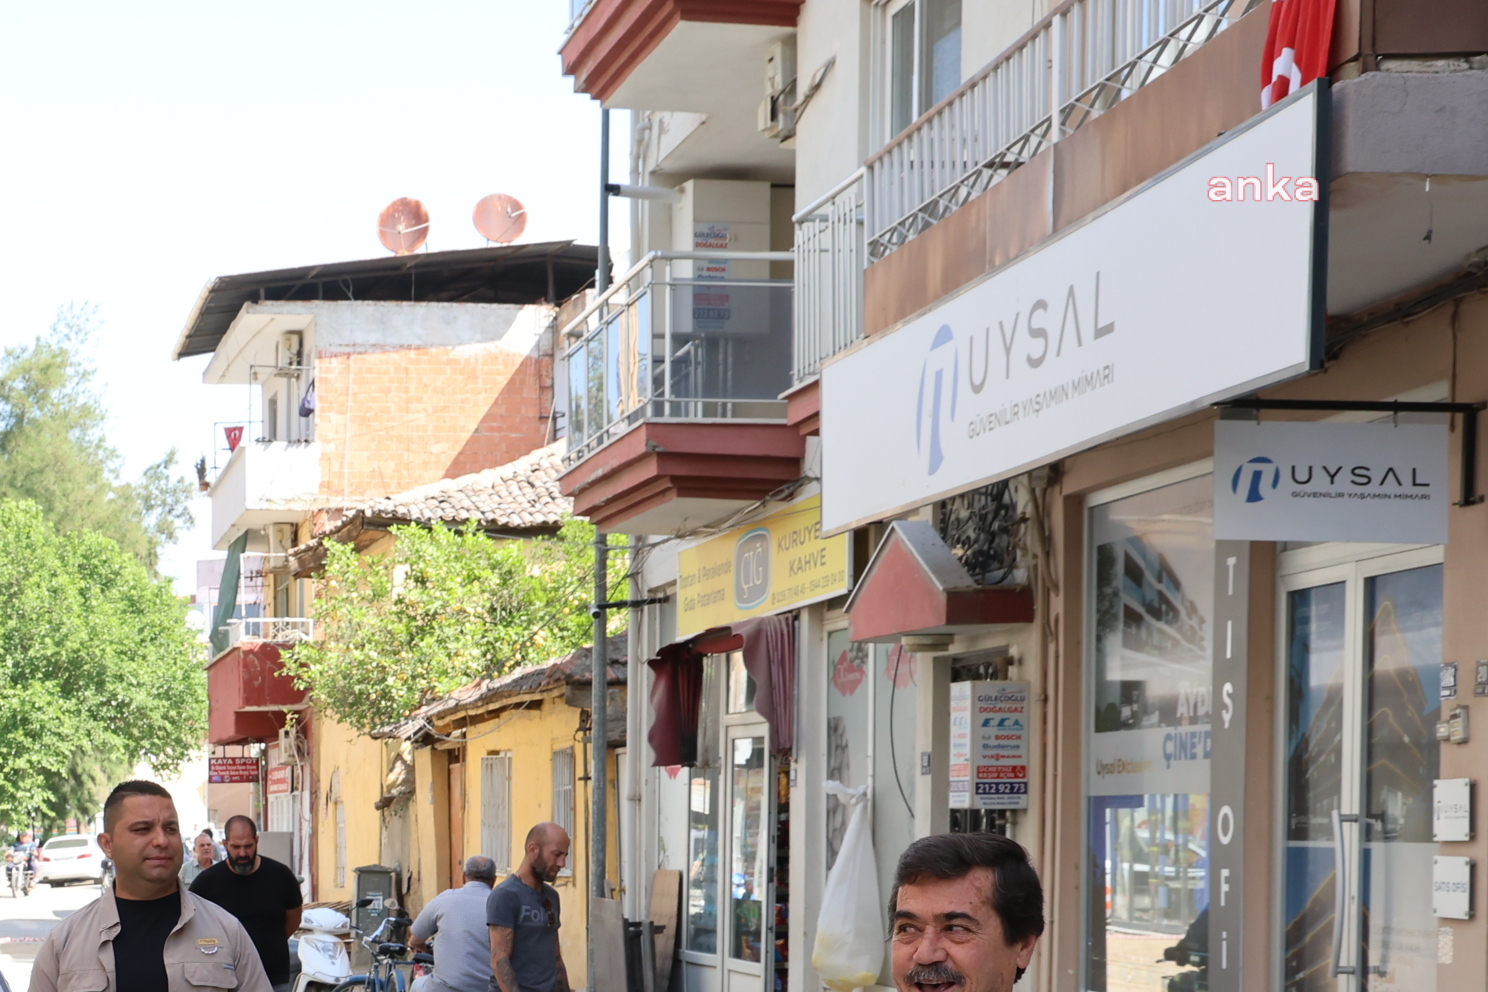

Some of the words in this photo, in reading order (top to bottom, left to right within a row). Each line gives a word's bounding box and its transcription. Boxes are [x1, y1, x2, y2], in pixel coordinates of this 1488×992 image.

[968, 270, 1115, 395] UYSAL
[967, 401, 1020, 439] GÜVENİLİR
[1021, 382, 1070, 418] YAŞAMIN
[1071, 362, 1115, 398] MİMARI
[1290, 464, 1431, 487] UYSAL
[1291, 490, 1345, 499] GÜVENİLİR
[1347, 492, 1392, 501] YAŞAMIN
[1393, 493, 1431, 501] MİMARI
[740, 543, 763, 598] ÇIĞ
[789, 547, 827, 578] KAHVE
[979, 705, 1024, 714] DOĞALGAZ
[977, 783, 996, 793] 212
[998, 783, 1011, 793] 92
[1012, 783, 1025, 793] 73
